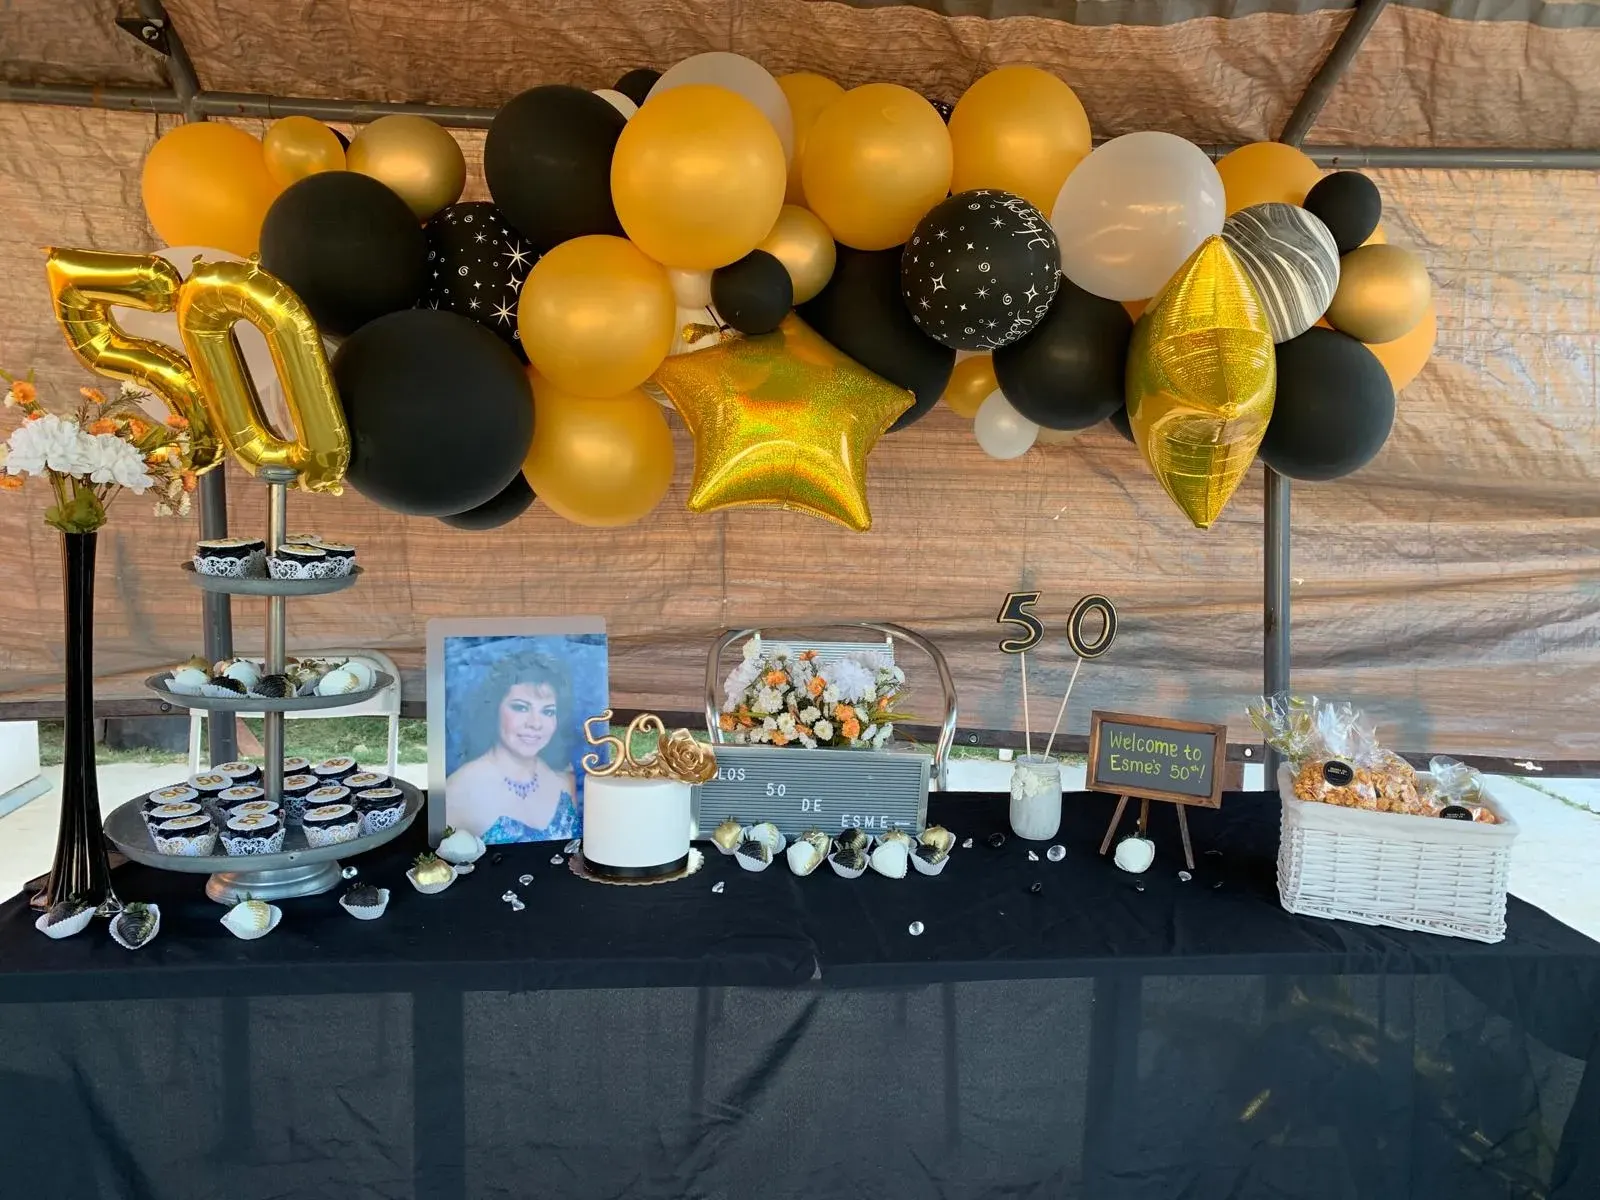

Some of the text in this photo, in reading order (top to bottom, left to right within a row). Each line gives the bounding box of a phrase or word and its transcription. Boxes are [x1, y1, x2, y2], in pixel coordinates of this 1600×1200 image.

[41, 246, 352, 496] 50
[997, 591, 1118, 658] 50
[582, 709, 666, 777] 50
[1110, 731, 1202, 761] Welcome to
[222, 763, 250, 772] 50
[1110, 754, 1161, 775] Esme's
[196, 774, 223, 785] 50
[718, 767, 746, 781] LOS
[766, 783, 786, 797] 50
[801, 799, 823, 812] DE
[238, 813, 265, 826] 50
[841, 814, 889, 829] ESME
